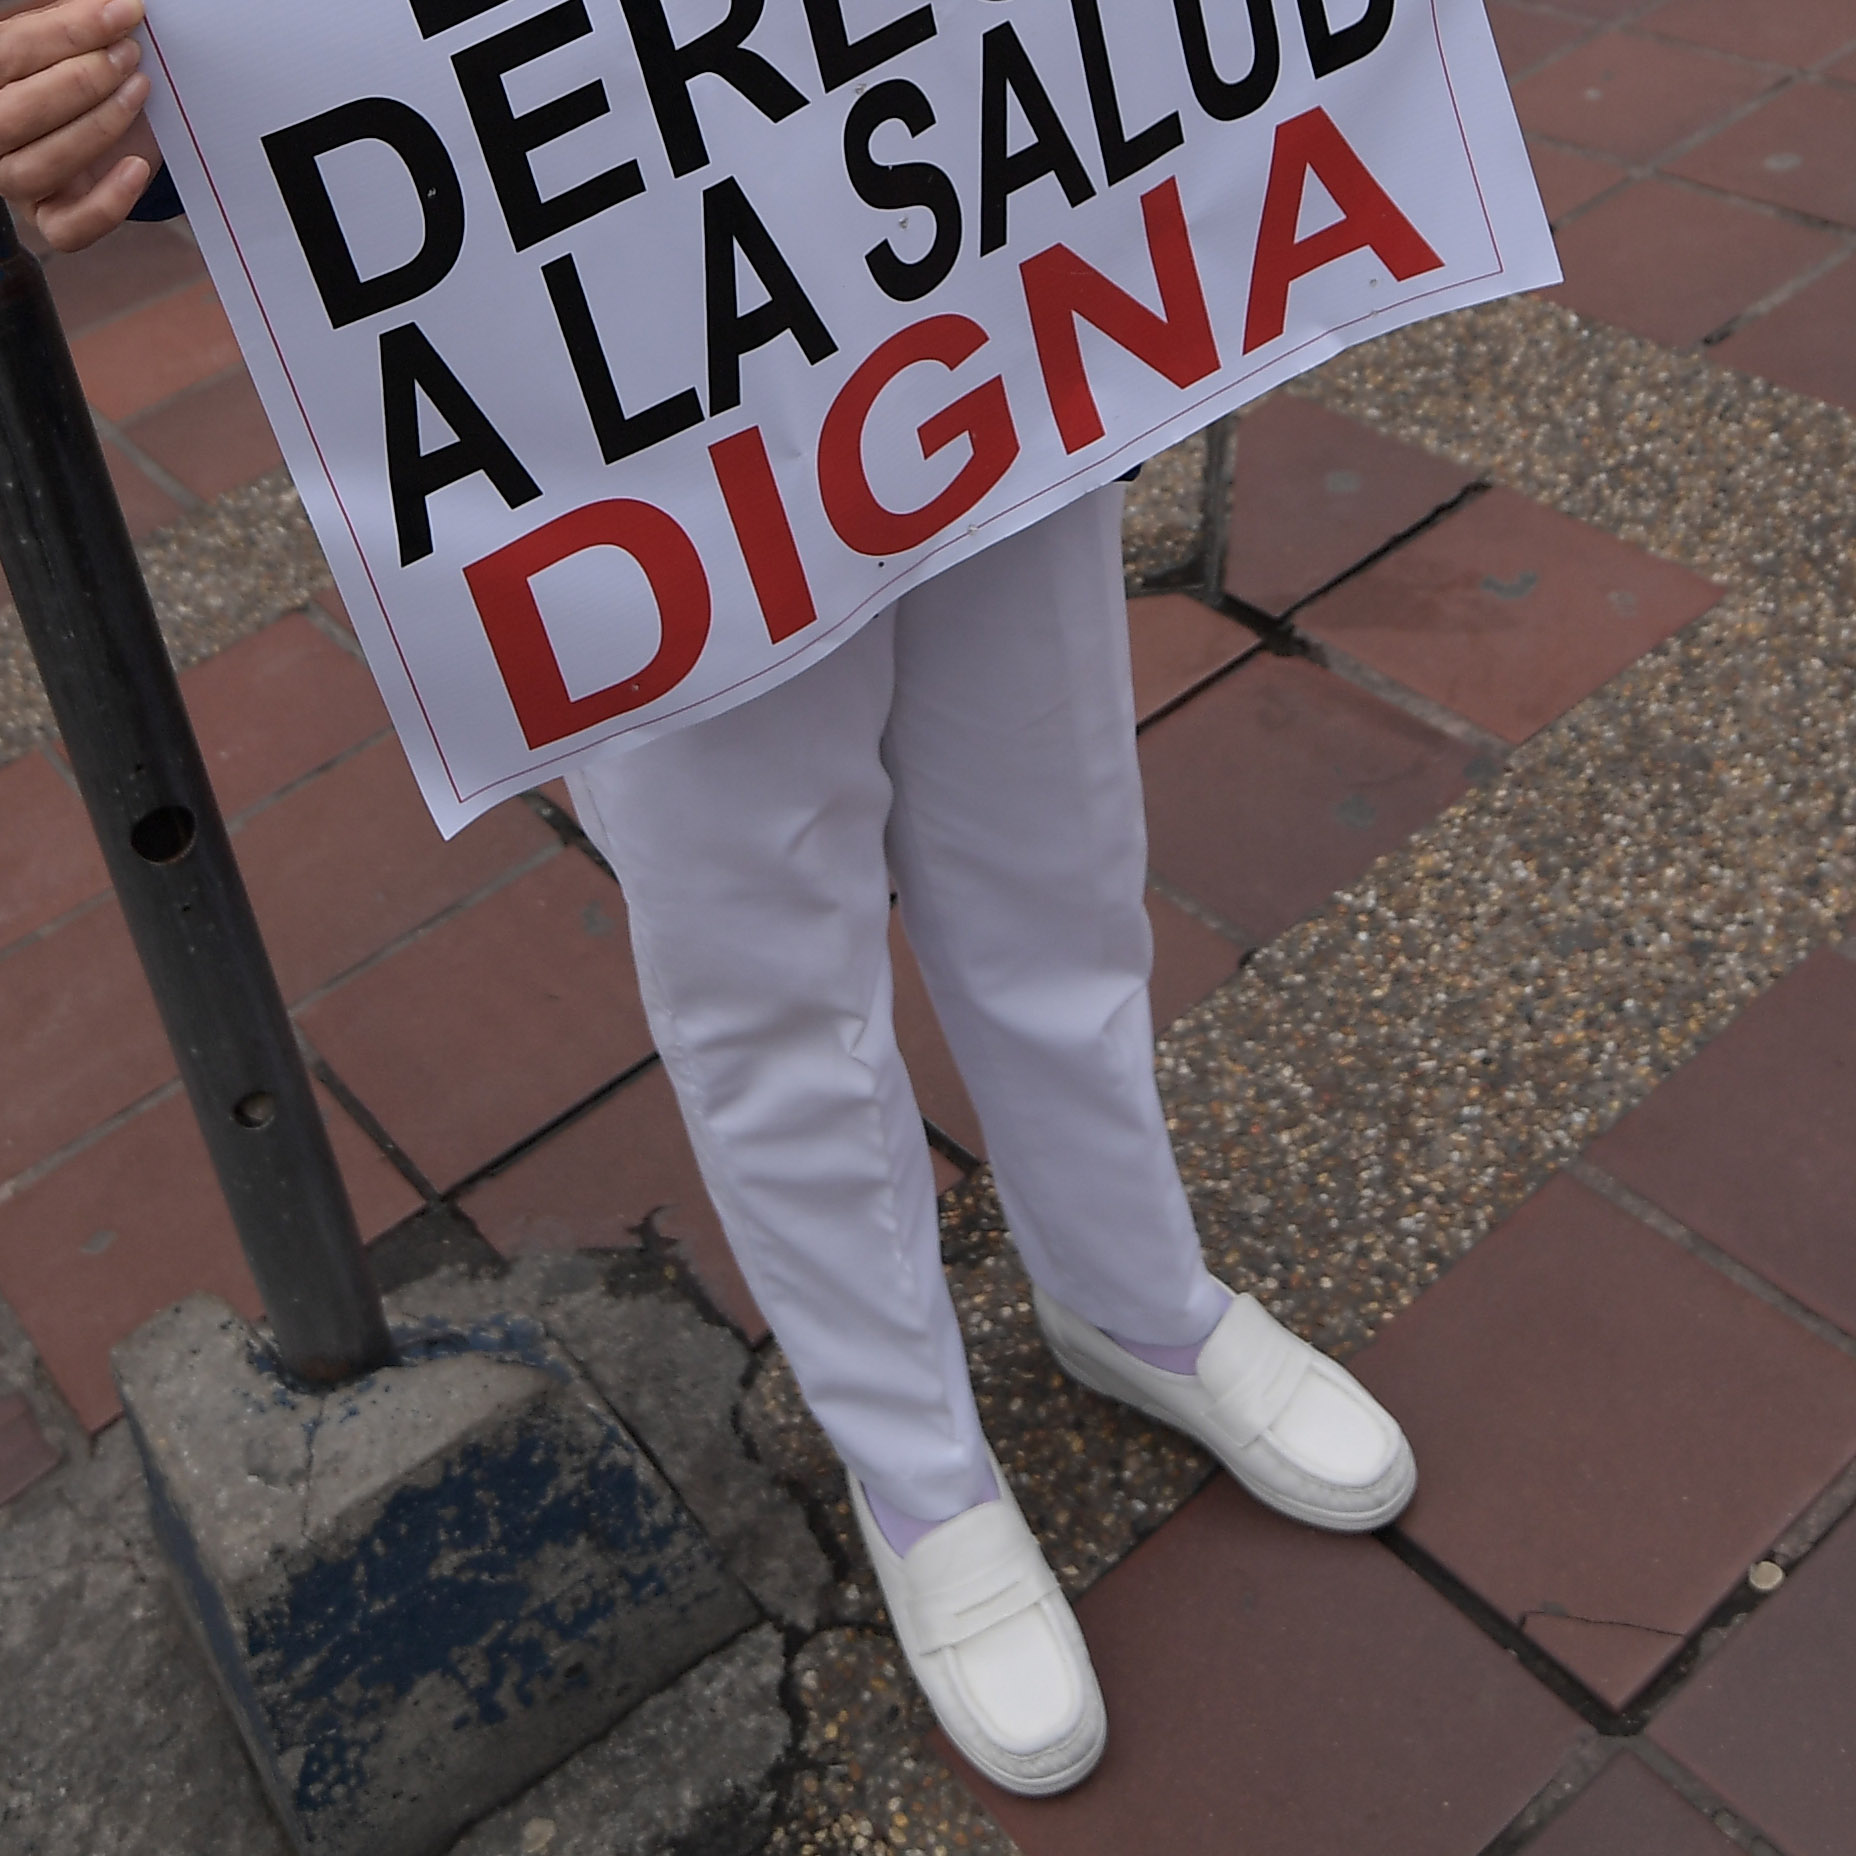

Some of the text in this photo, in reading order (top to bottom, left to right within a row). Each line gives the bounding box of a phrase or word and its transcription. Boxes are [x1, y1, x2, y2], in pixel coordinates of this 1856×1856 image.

[379, 322, 542, 567] A
[541, 176, 839, 466] LA
[462, 107, 1444, 750] DIGNA
